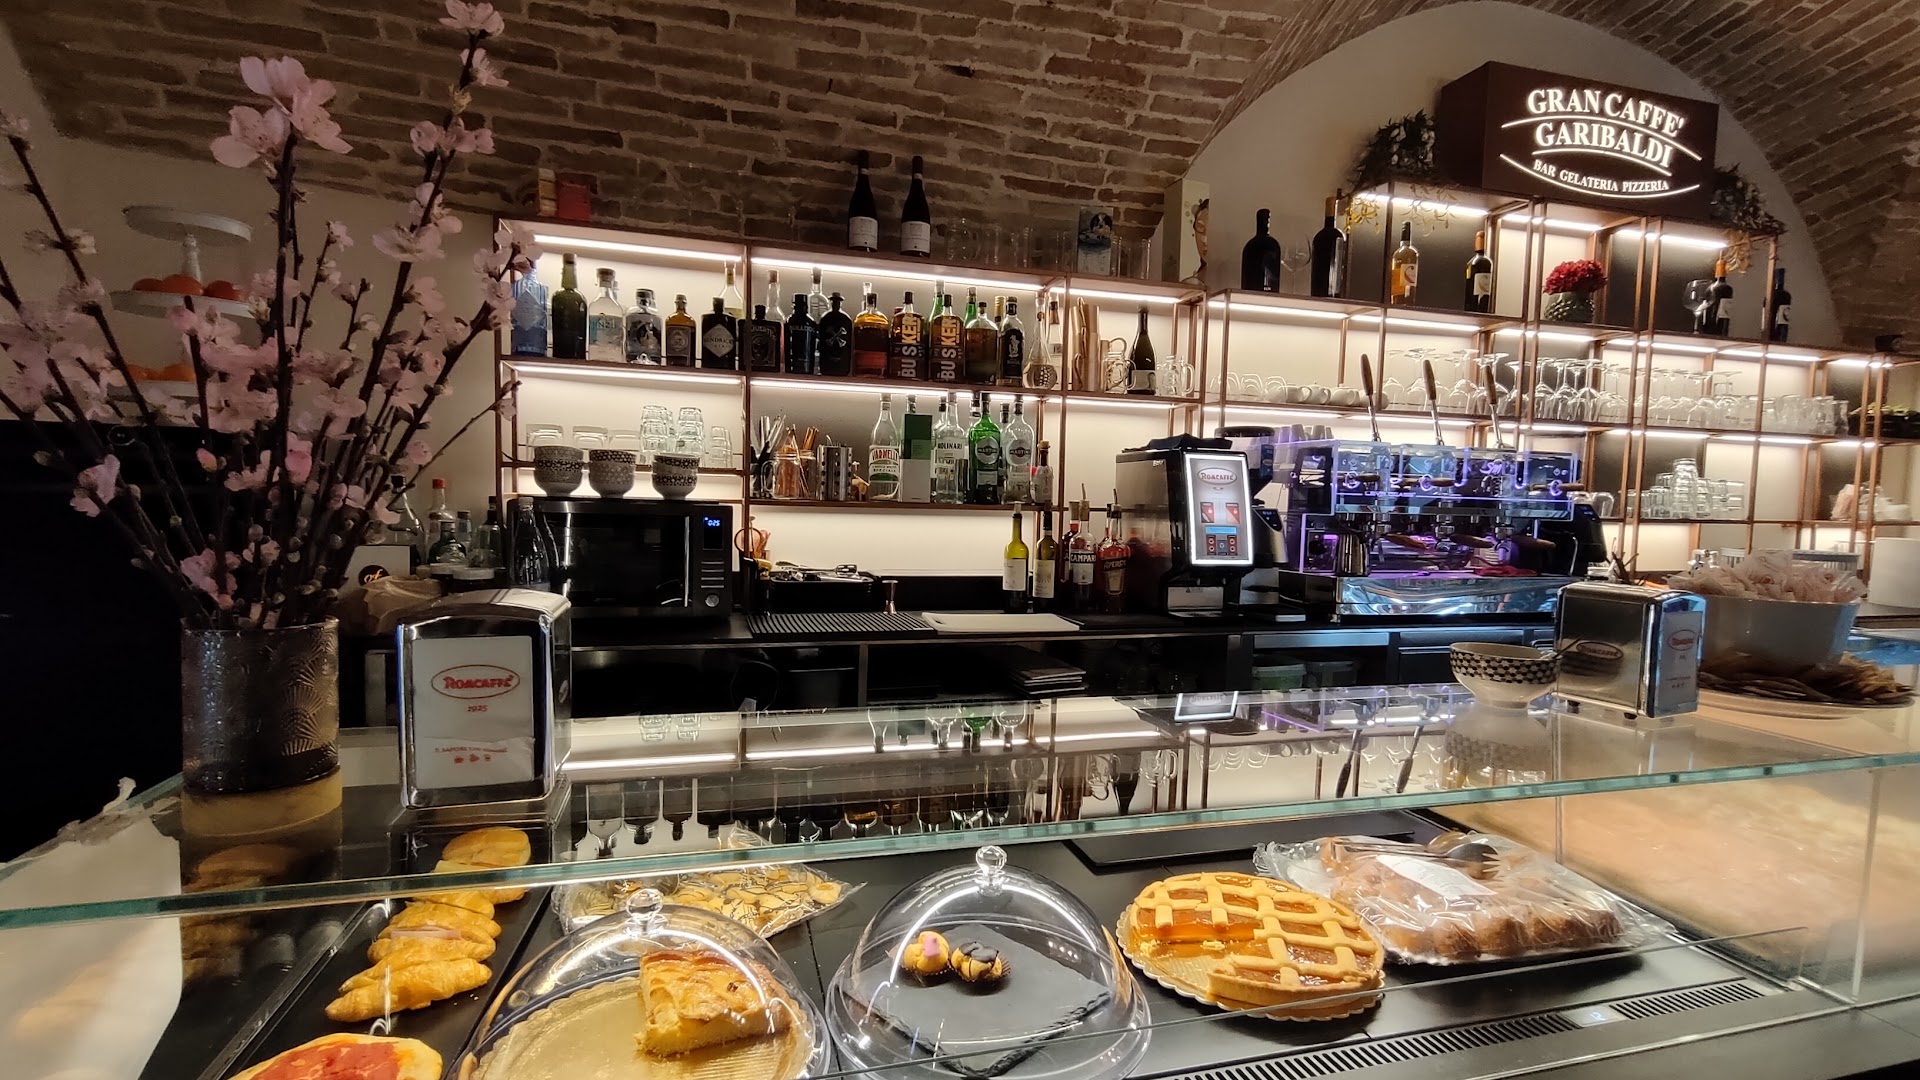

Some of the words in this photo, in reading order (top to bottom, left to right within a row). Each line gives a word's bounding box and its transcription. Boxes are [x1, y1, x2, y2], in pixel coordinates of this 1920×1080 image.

[1527, 89, 1601, 114] GRAN
[1535, 122, 1674, 168] GARIBALDI
[1533, 159, 1556, 178] BAR
[1559, 169, 1619, 192] GELATERIA
[1622, 179, 1670, 192] PIZZERIA
[901, 313, 917, 378] BUSKER
[940, 316, 957, 380] BUSKER
